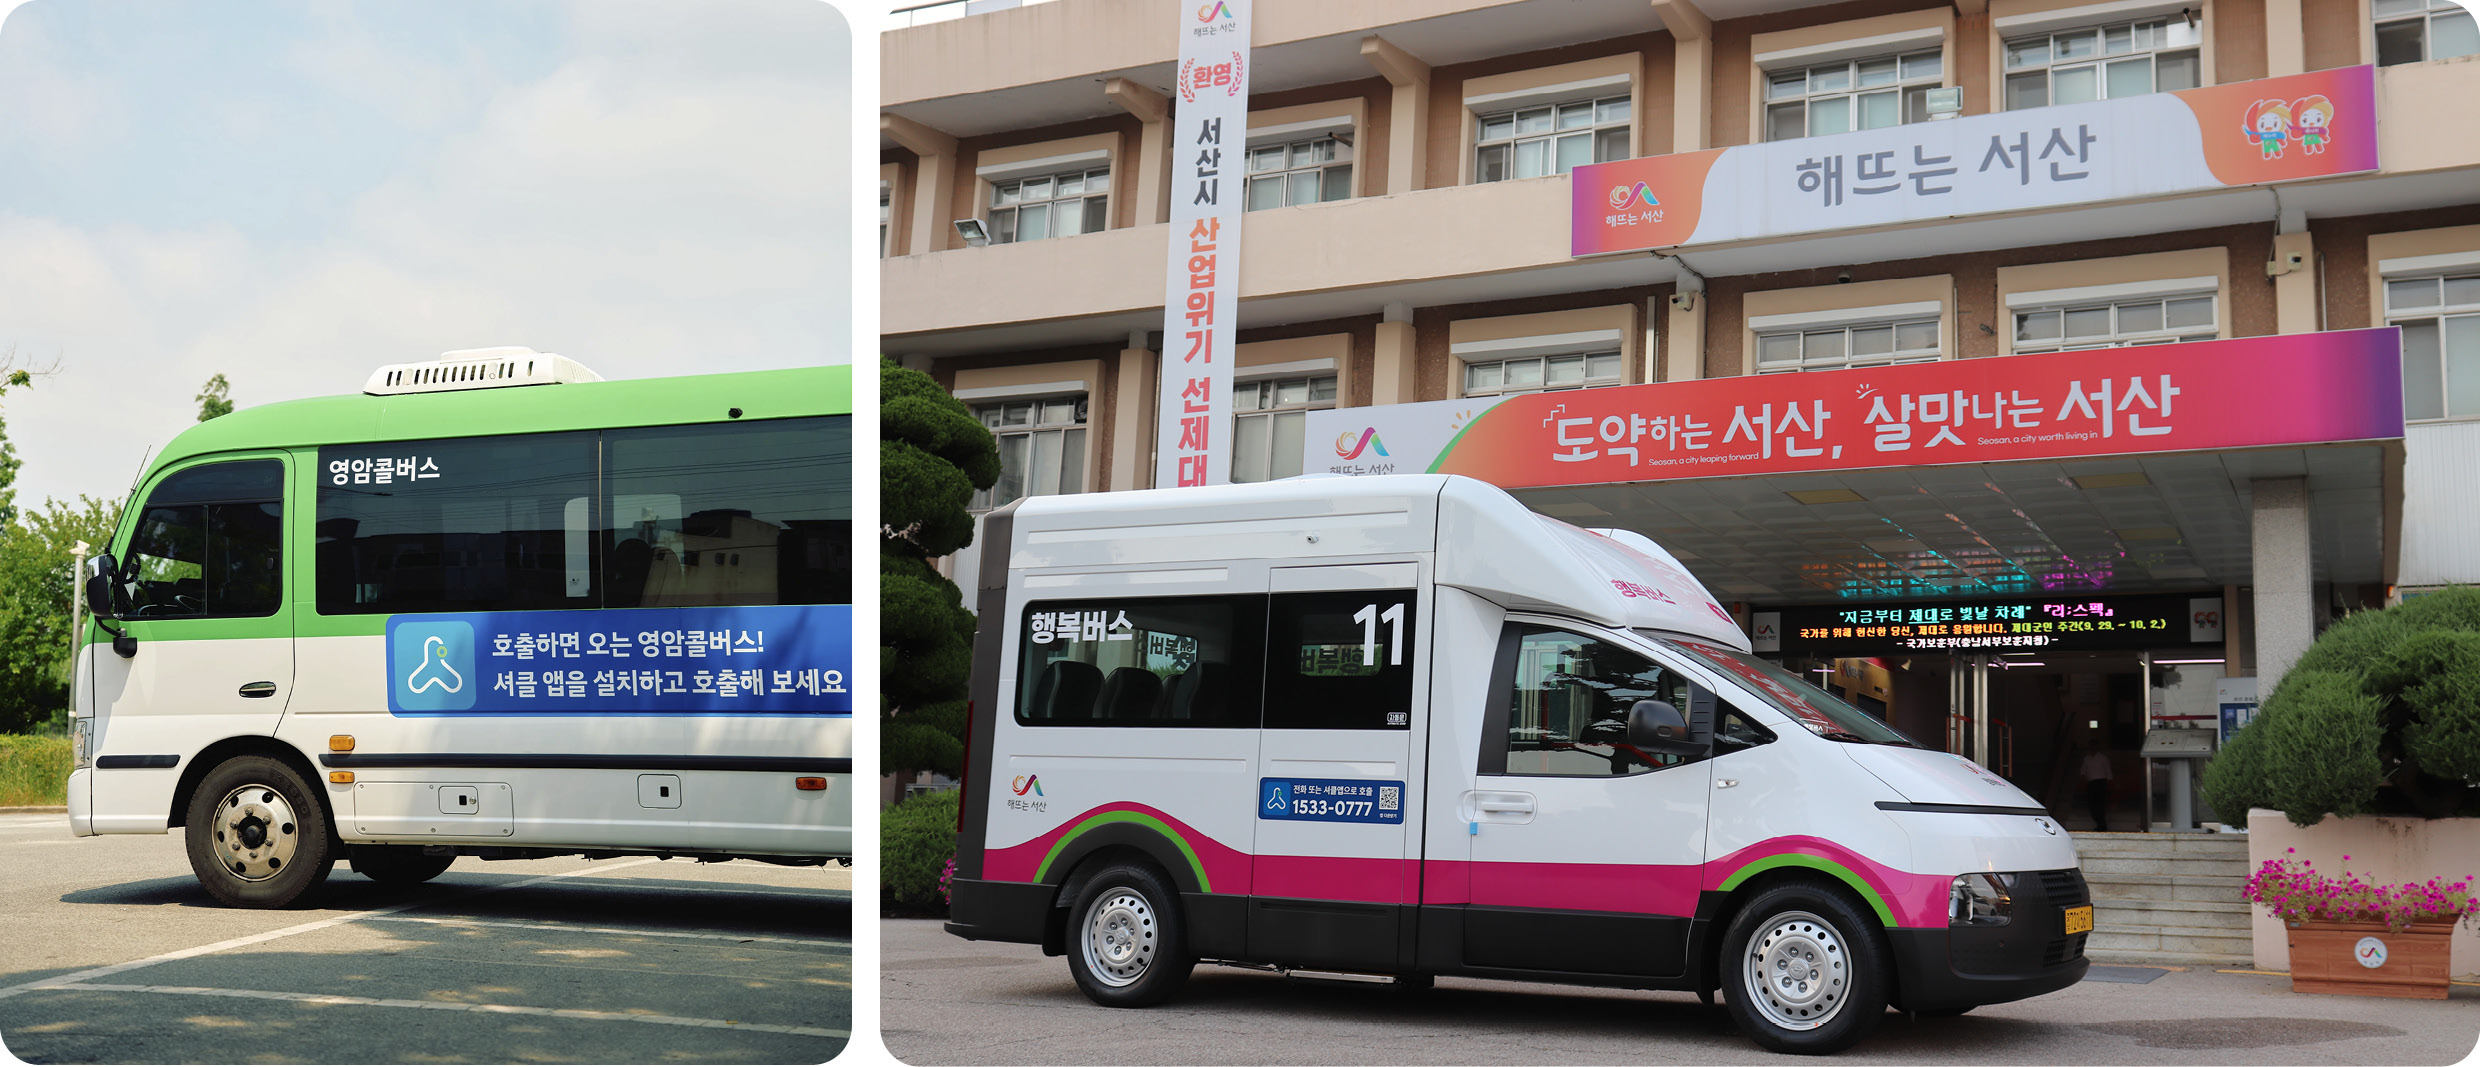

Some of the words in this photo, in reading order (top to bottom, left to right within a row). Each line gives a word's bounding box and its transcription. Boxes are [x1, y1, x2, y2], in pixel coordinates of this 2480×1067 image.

[1193, 26, 1217, 37] 해뜨는
[1219, 21, 1236, 32] 서산
[1193, 62, 1232, 90] 환영
[1193, 117, 1222, 206] 서산시
[1796, 144, 1958, 207] 해뜨는
[1978, 124, 2097, 186] 서산
[1605, 213, 1638, 228] 해뜨는
[1641, 209, 1664, 223] 서산
[1184, 216, 1221, 364] 산업위기
[1553, 413, 1712, 467] 도약하는
[1722, 399, 1843, 460] 서산,
[1863, 390, 2044, 452] 살맛나는
[2056, 374, 2181, 438] 서산
[1978, 436, 2012, 446] Seosan,
[2020, 435, 2037, 445] city
[2038, 432, 2064, 442] worth
[2065, 431, 2088, 442] living
[2089, 431, 2098, 439] in
[329, 456, 440, 485] 영암콜버스
[1649, 457, 1678, 466] Seosan,
[1685, 456, 1699, 465] city
[1700, 454, 1728, 464] leaping
[1728, 452, 1759, 461] forward
[1610, 579, 1677, 605] 행복버스
[1031, 610, 1133, 644] 행복버스
[1800, 628, 1829, 638] 국가를
[1832, 627, 1852, 638] 위해
[1856, 627, 1887, 637] 헌신한
[1891, 626, 1914, 637] 당신,
[1918, 625, 1948, 636] 제대로
[1953, 623, 2007, 635] 응원합니다.
[2011, 622, 2053, 633] 제대군인
[2098, 620, 2115, 631] 29.
[2130, 619, 2147, 630] 10.
[1908, 608, 1953, 624] 제대로
[1960, 606, 1989, 621] 빛날
[492, 631, 581, 659] 호출하면
[586, 631, 633, 657] 오는
[637, 629, 765, 658] 영암콜버스!
[1353, 603, 1404, 666] 11
[493, 670, 538, 698] 셔클
[542, 670, 588, 697] 앱을
[593, 669, 687, 697] 설치하고
[692, 668, 764, 697] 호출해
[771, 668, 847, 696] 보세요
[1293, 785, 1307, 795] 전화
[1308, 785, 1322, 795] 또는
[1323, 786, 1357, 796] 셔클앱으로
[1358, 786, 1373, 796] 호출
[1007, 799, 1029, 811] 해뜨는
[1031, 801, 1047, 813] 서산
[1292, 799, 1373, 817] 1533-0777
